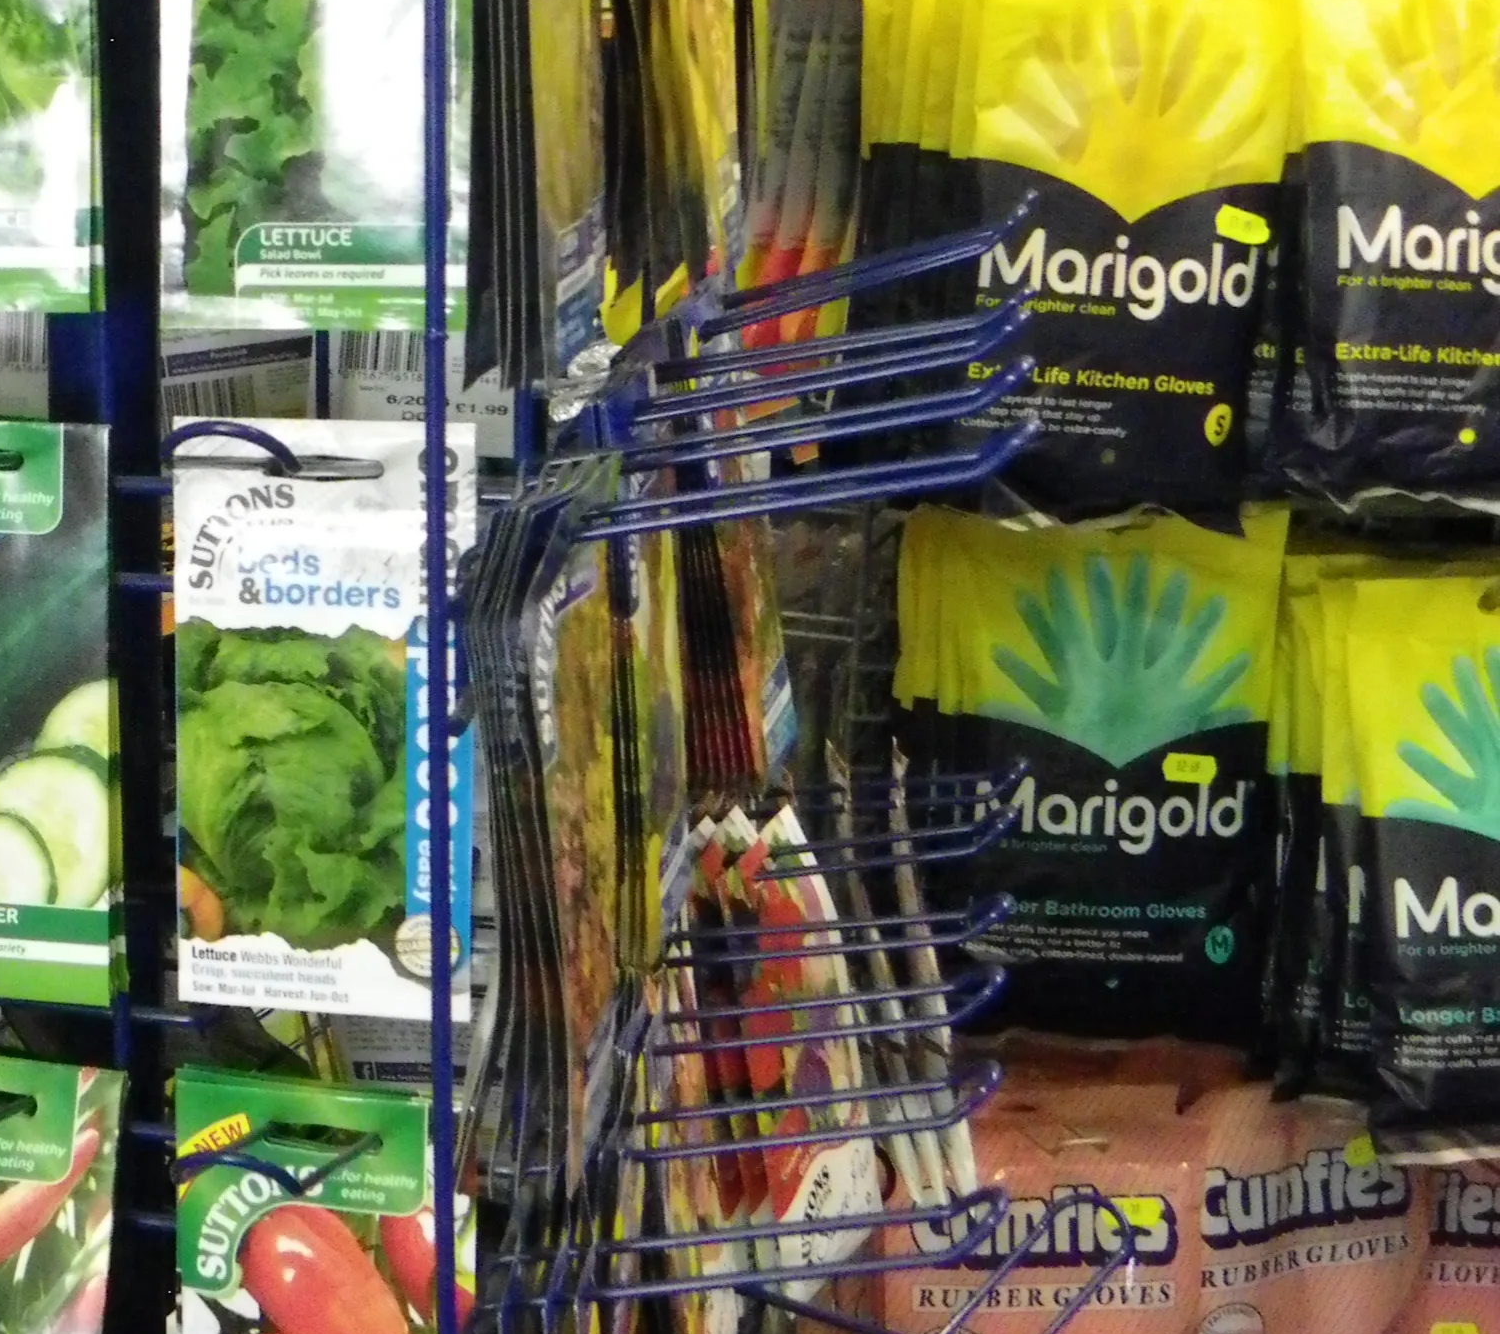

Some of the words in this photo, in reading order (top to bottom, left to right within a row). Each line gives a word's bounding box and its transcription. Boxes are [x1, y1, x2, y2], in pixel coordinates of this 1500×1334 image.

[259, 228, 353, 247] LETTUCE
[259, 249, 288, 261] Salad
[291, 248, 322, 260] Bowl
[259, 267, 283, 279] Pick
[287, 267, 320, 280] leaves
[322, 270, 336, 280] as
[337, 267, 386, 281] required
[977, 228, 1260, 320] Marigold
[975, 293, 1000, 309] For
[1075, 301, 1116, 317] clean
[1334, 342, 1432, 363] Extra-Life
[1076, 369, 1150, 391] Kitchen
[1154, 374, 1216, 396] Gloves
[2, 491, 56, 508] healthy
[188, 483, 296, 591] SUTTONS
[264, 578, 401, 609] borders
[974, 777, 1248, 855] Marigold
[1045, 899, 1141, 919] Bathroom
[1146, 902, 1208, 920] Gloves
[192, 946, 238, 964] Lettuce
[240, 950, 281, 967] Webbs
[283, 954, 343, 971] Wonderful
[230, 968, 294, 984] succulent
[297, 972, 337, 986] heads
[1399, 1008, 1475, 1031] Longer
[16, 1140, 67, 1156] healthy
[192, 1120, 244, 1153] NEW
[363, 1172, 417, 1190] healthy
[340, 1187, 386, 1204] eating
[1200, 1157, 1410, 1239] Cumfies
[1200, 1251, 1300, 1289] RUBBER
[1305, 1230, 1411, 1267] GLOVES
